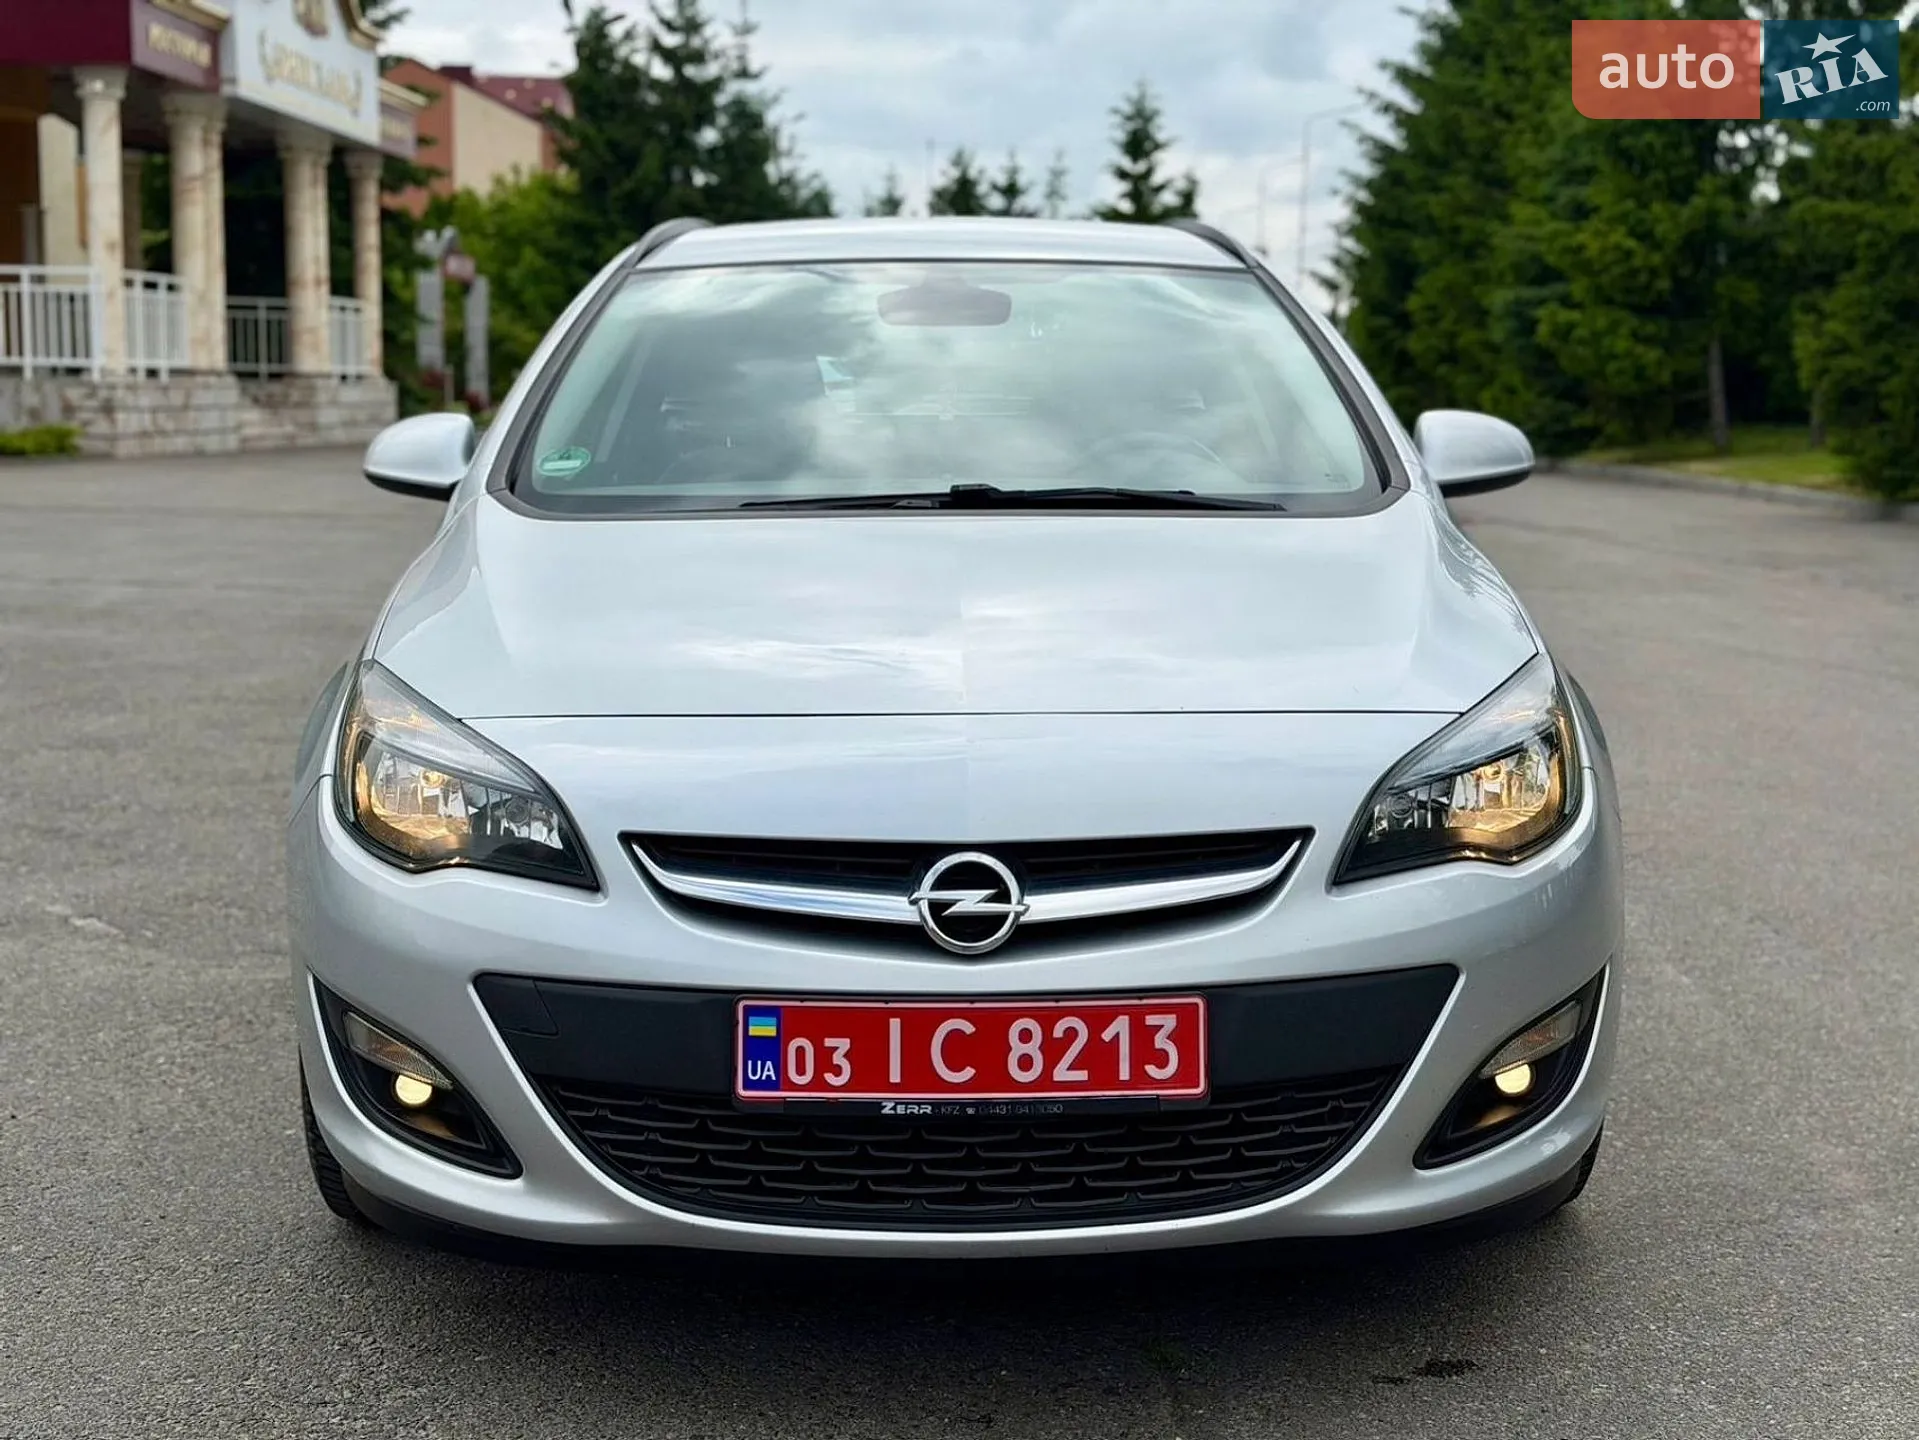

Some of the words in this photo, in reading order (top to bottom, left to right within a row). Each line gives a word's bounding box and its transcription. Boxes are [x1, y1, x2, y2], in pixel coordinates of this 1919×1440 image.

[747, 1060, 776, 1081] UA
[786, 1037, 852, 1087] 03
[1006, 1014, 1179, 1083] 8213
